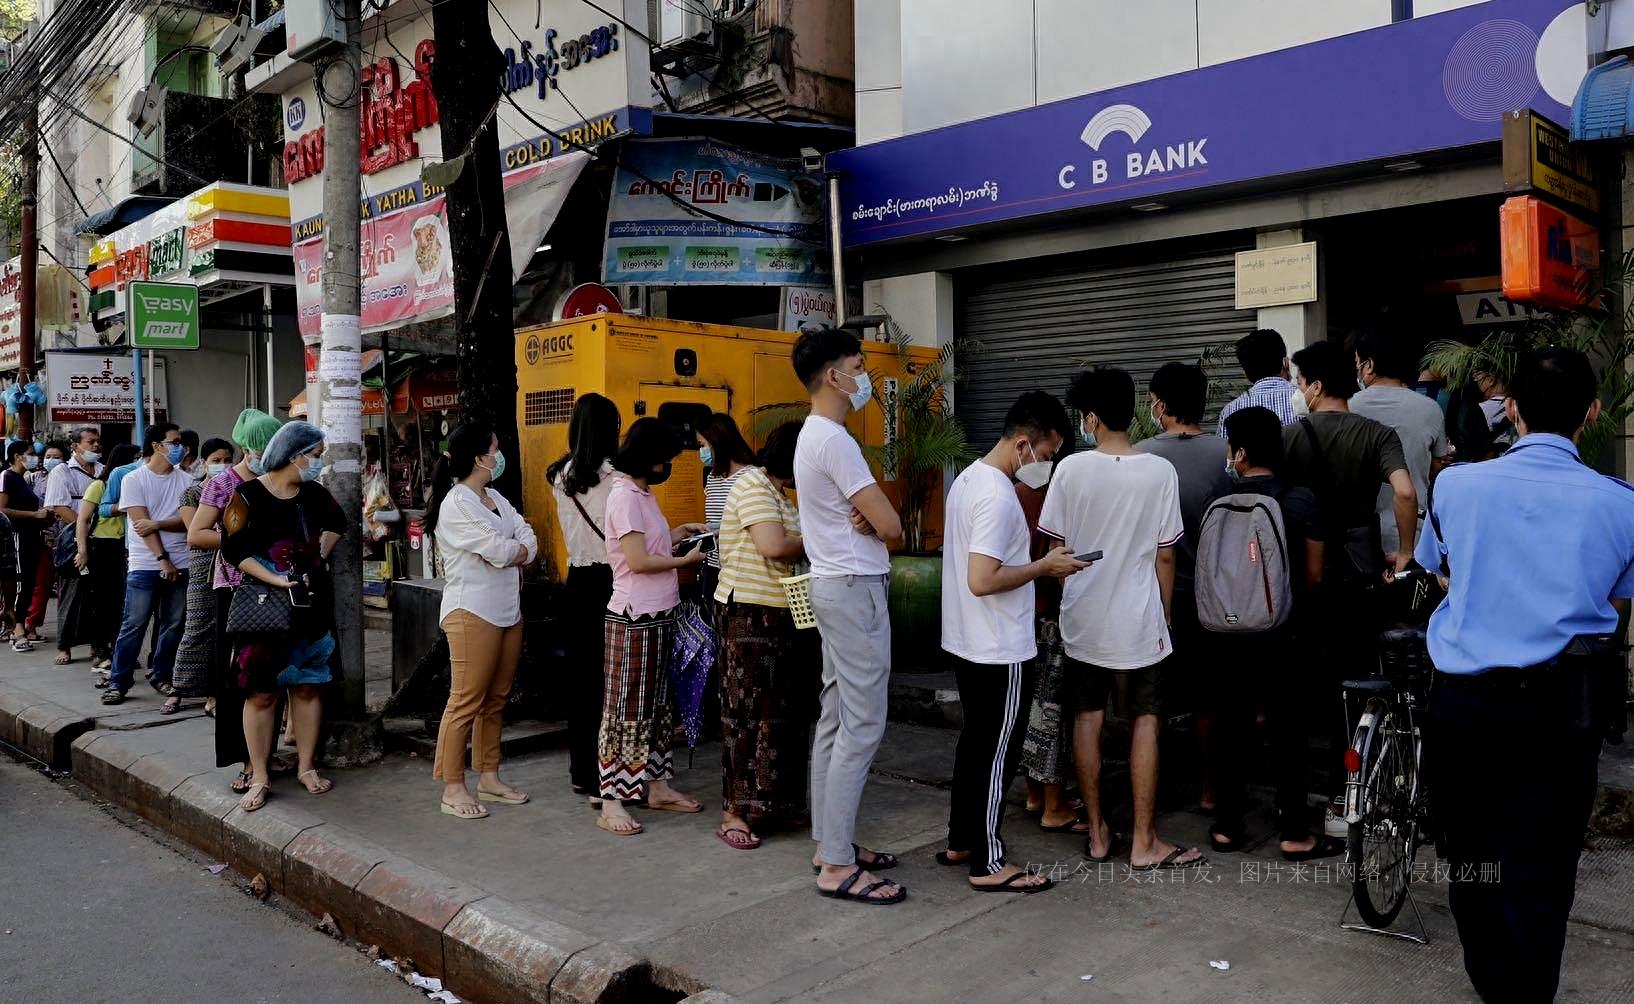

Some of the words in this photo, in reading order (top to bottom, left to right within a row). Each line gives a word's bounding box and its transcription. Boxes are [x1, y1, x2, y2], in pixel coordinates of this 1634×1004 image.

[1058, 165, 1076, 189] C
[1092, 159, 1108, 184] B
[1127, 138, 1208, 178] BANK
[295, 218, 325, 238] KAUN
[376, 186, 416, 212] YATHA
[505, 138, 550, 168] COLD
[559, 114, 617, 150] DRINK
[1476, 297, 1532, 318] AT
[147, 322, 185, 335] mart
[542, 334, 573, 356] AGGC
